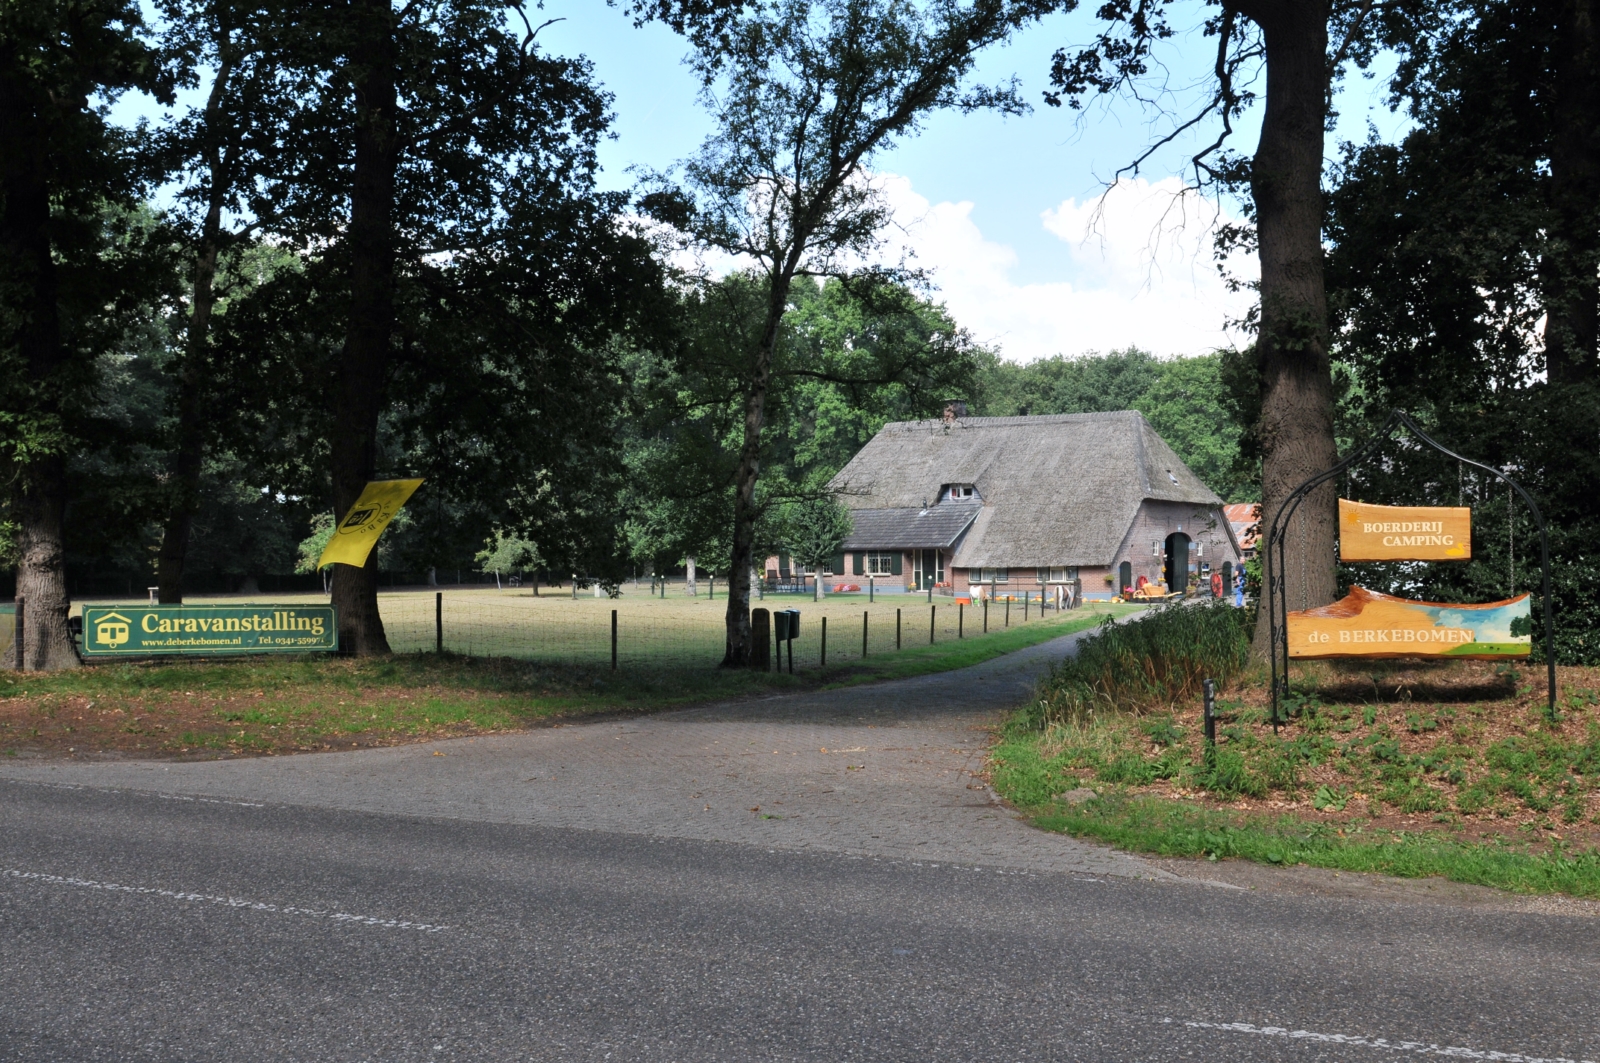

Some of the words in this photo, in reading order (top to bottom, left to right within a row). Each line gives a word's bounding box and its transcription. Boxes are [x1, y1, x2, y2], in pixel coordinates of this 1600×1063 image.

[1363, 521, 1443, 534] BOERDERIJ
[1382, 535, 1454, 546] CAMPING
[141, 611, 325, 635] Caravanstalling
[141, 636, 242, 646] www.deberkebomen.nl
[258, 636, 274, 645] Tel.
[1308, 630, 1329, 643] de
[1339, 629, 1473, 643] BERKEBOMEN
